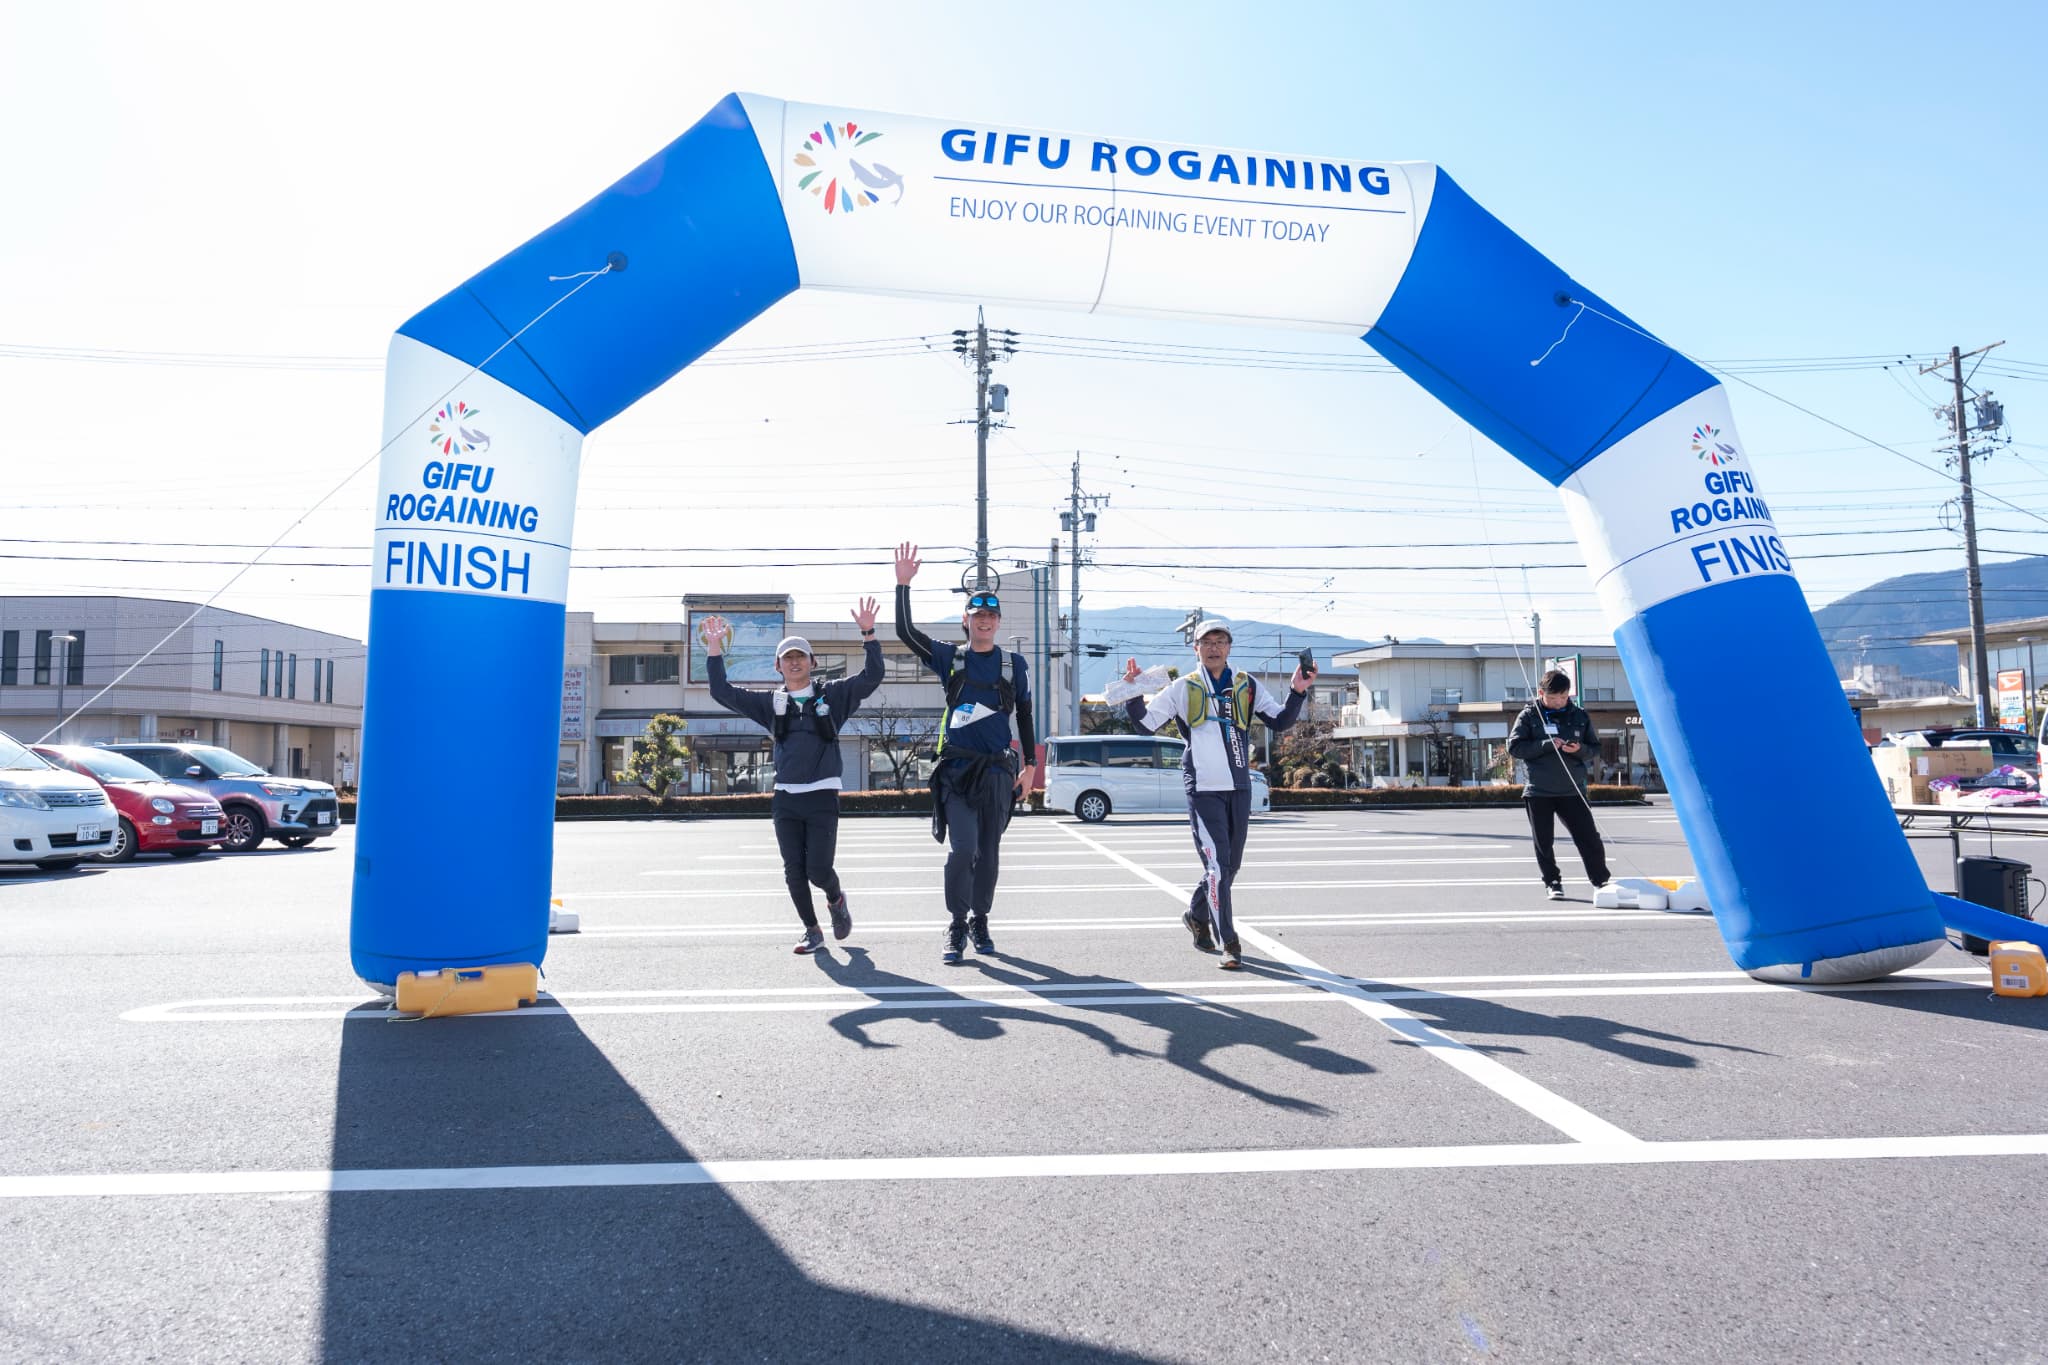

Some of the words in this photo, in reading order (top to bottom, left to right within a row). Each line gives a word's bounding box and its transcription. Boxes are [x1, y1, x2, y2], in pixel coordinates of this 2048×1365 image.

[941, 129, 1070, 170] GIFU
[1091, 141, 1390, 196] ROGAINING
[950, 197, 1017, 221] ENJOY
[1023, 202, 1068, 224] OUR
[1074, 204, 1188, 233] ROGAINING
[1193, 214, 1256, 238] EVENT
[1261, 219, 1330, 242] TODAY
[423, 461, 495, 494] GIFU
[1704, 470, 1754, 495] GIFU
[386, 493, 539, 533] ROGAINING
[386, 541, 530, 594] FINISH
